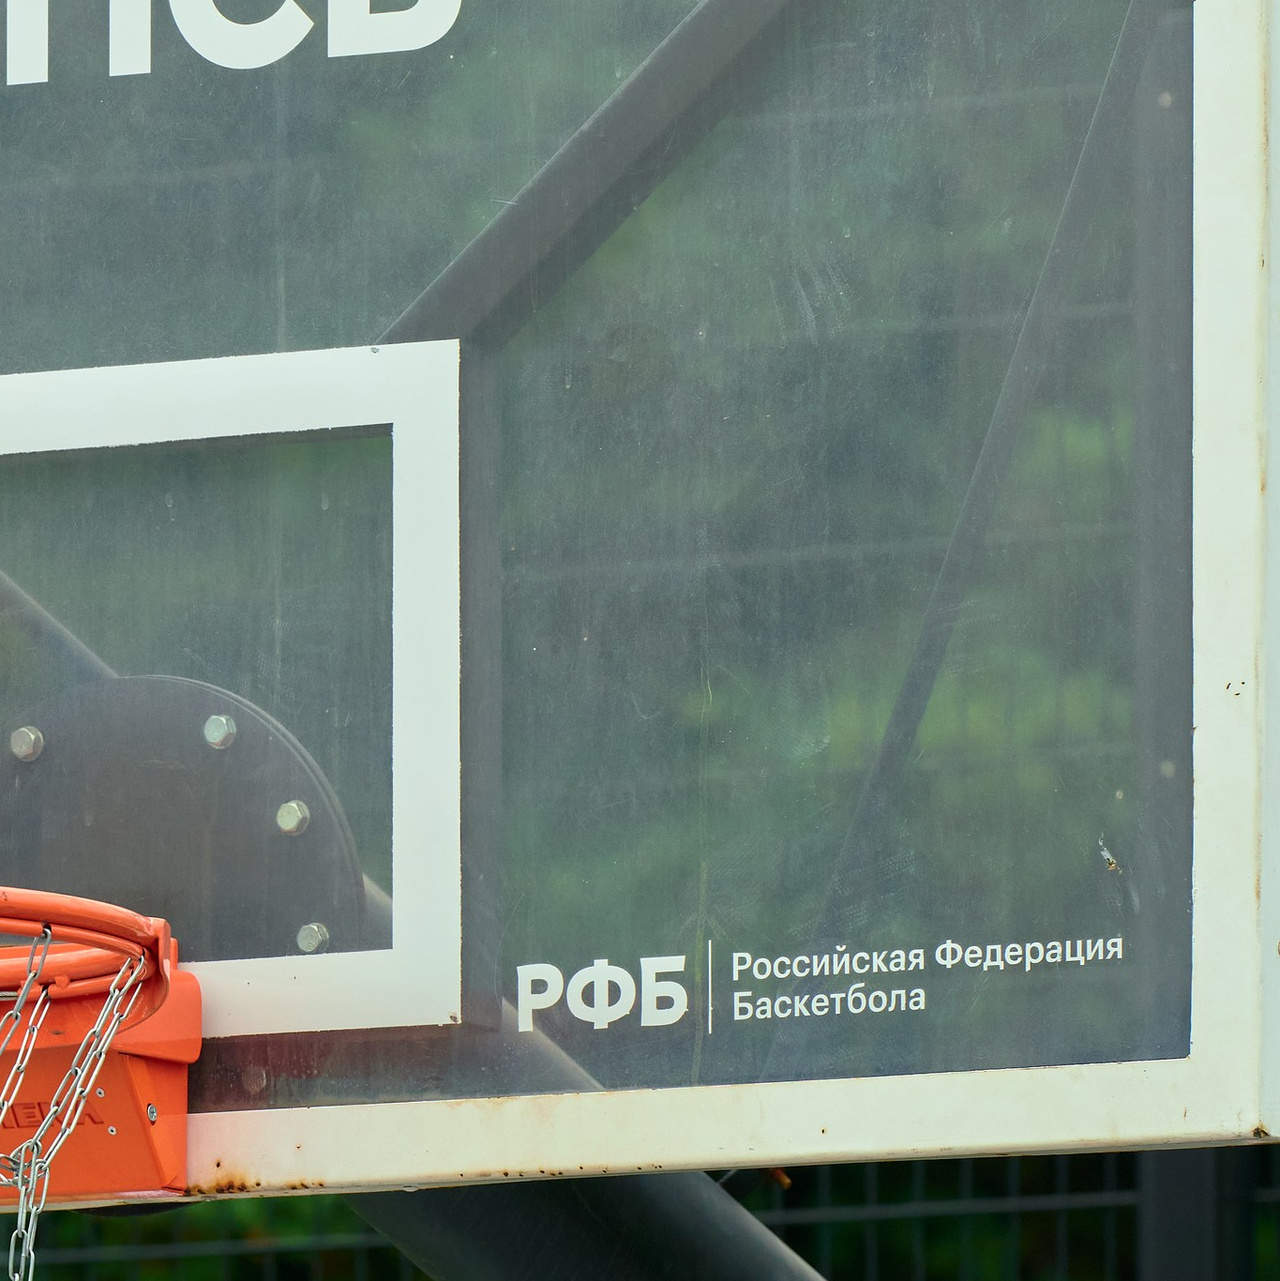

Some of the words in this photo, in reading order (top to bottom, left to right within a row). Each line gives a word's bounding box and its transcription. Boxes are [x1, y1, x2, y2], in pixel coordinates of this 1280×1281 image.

[732, 944, 926, 981] Российская
[935, 937, 1124, 972] Федерация
[516, 955, 689, 1033] РФБ
[733, 982, 926, 1021] Баскетбола
